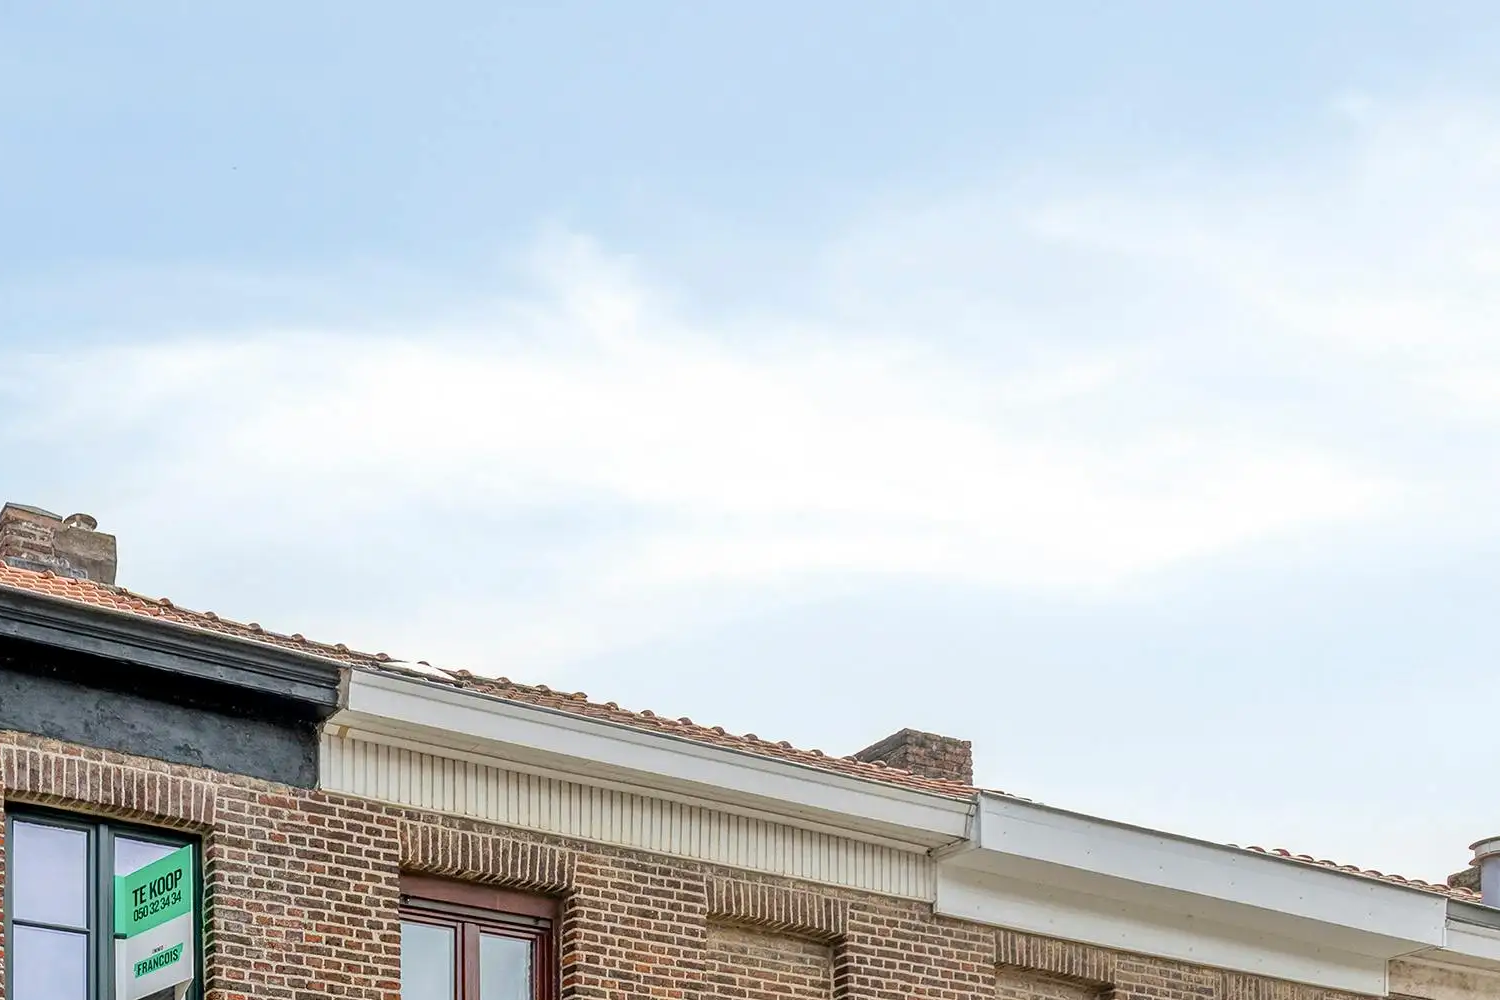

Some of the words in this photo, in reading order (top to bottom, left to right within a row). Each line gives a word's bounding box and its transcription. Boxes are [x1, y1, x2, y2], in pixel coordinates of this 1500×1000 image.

[132, 885, 147, 907] TE
[149, 868, 182, 900] KOOP
[133, 905, 149, 921] 050
[149, 900, 160, 915] 32
[160, 895, 170, 910] 34
[171, 890, 182, 905] 34
[137, 949, 179, 976] FRANCOIS
